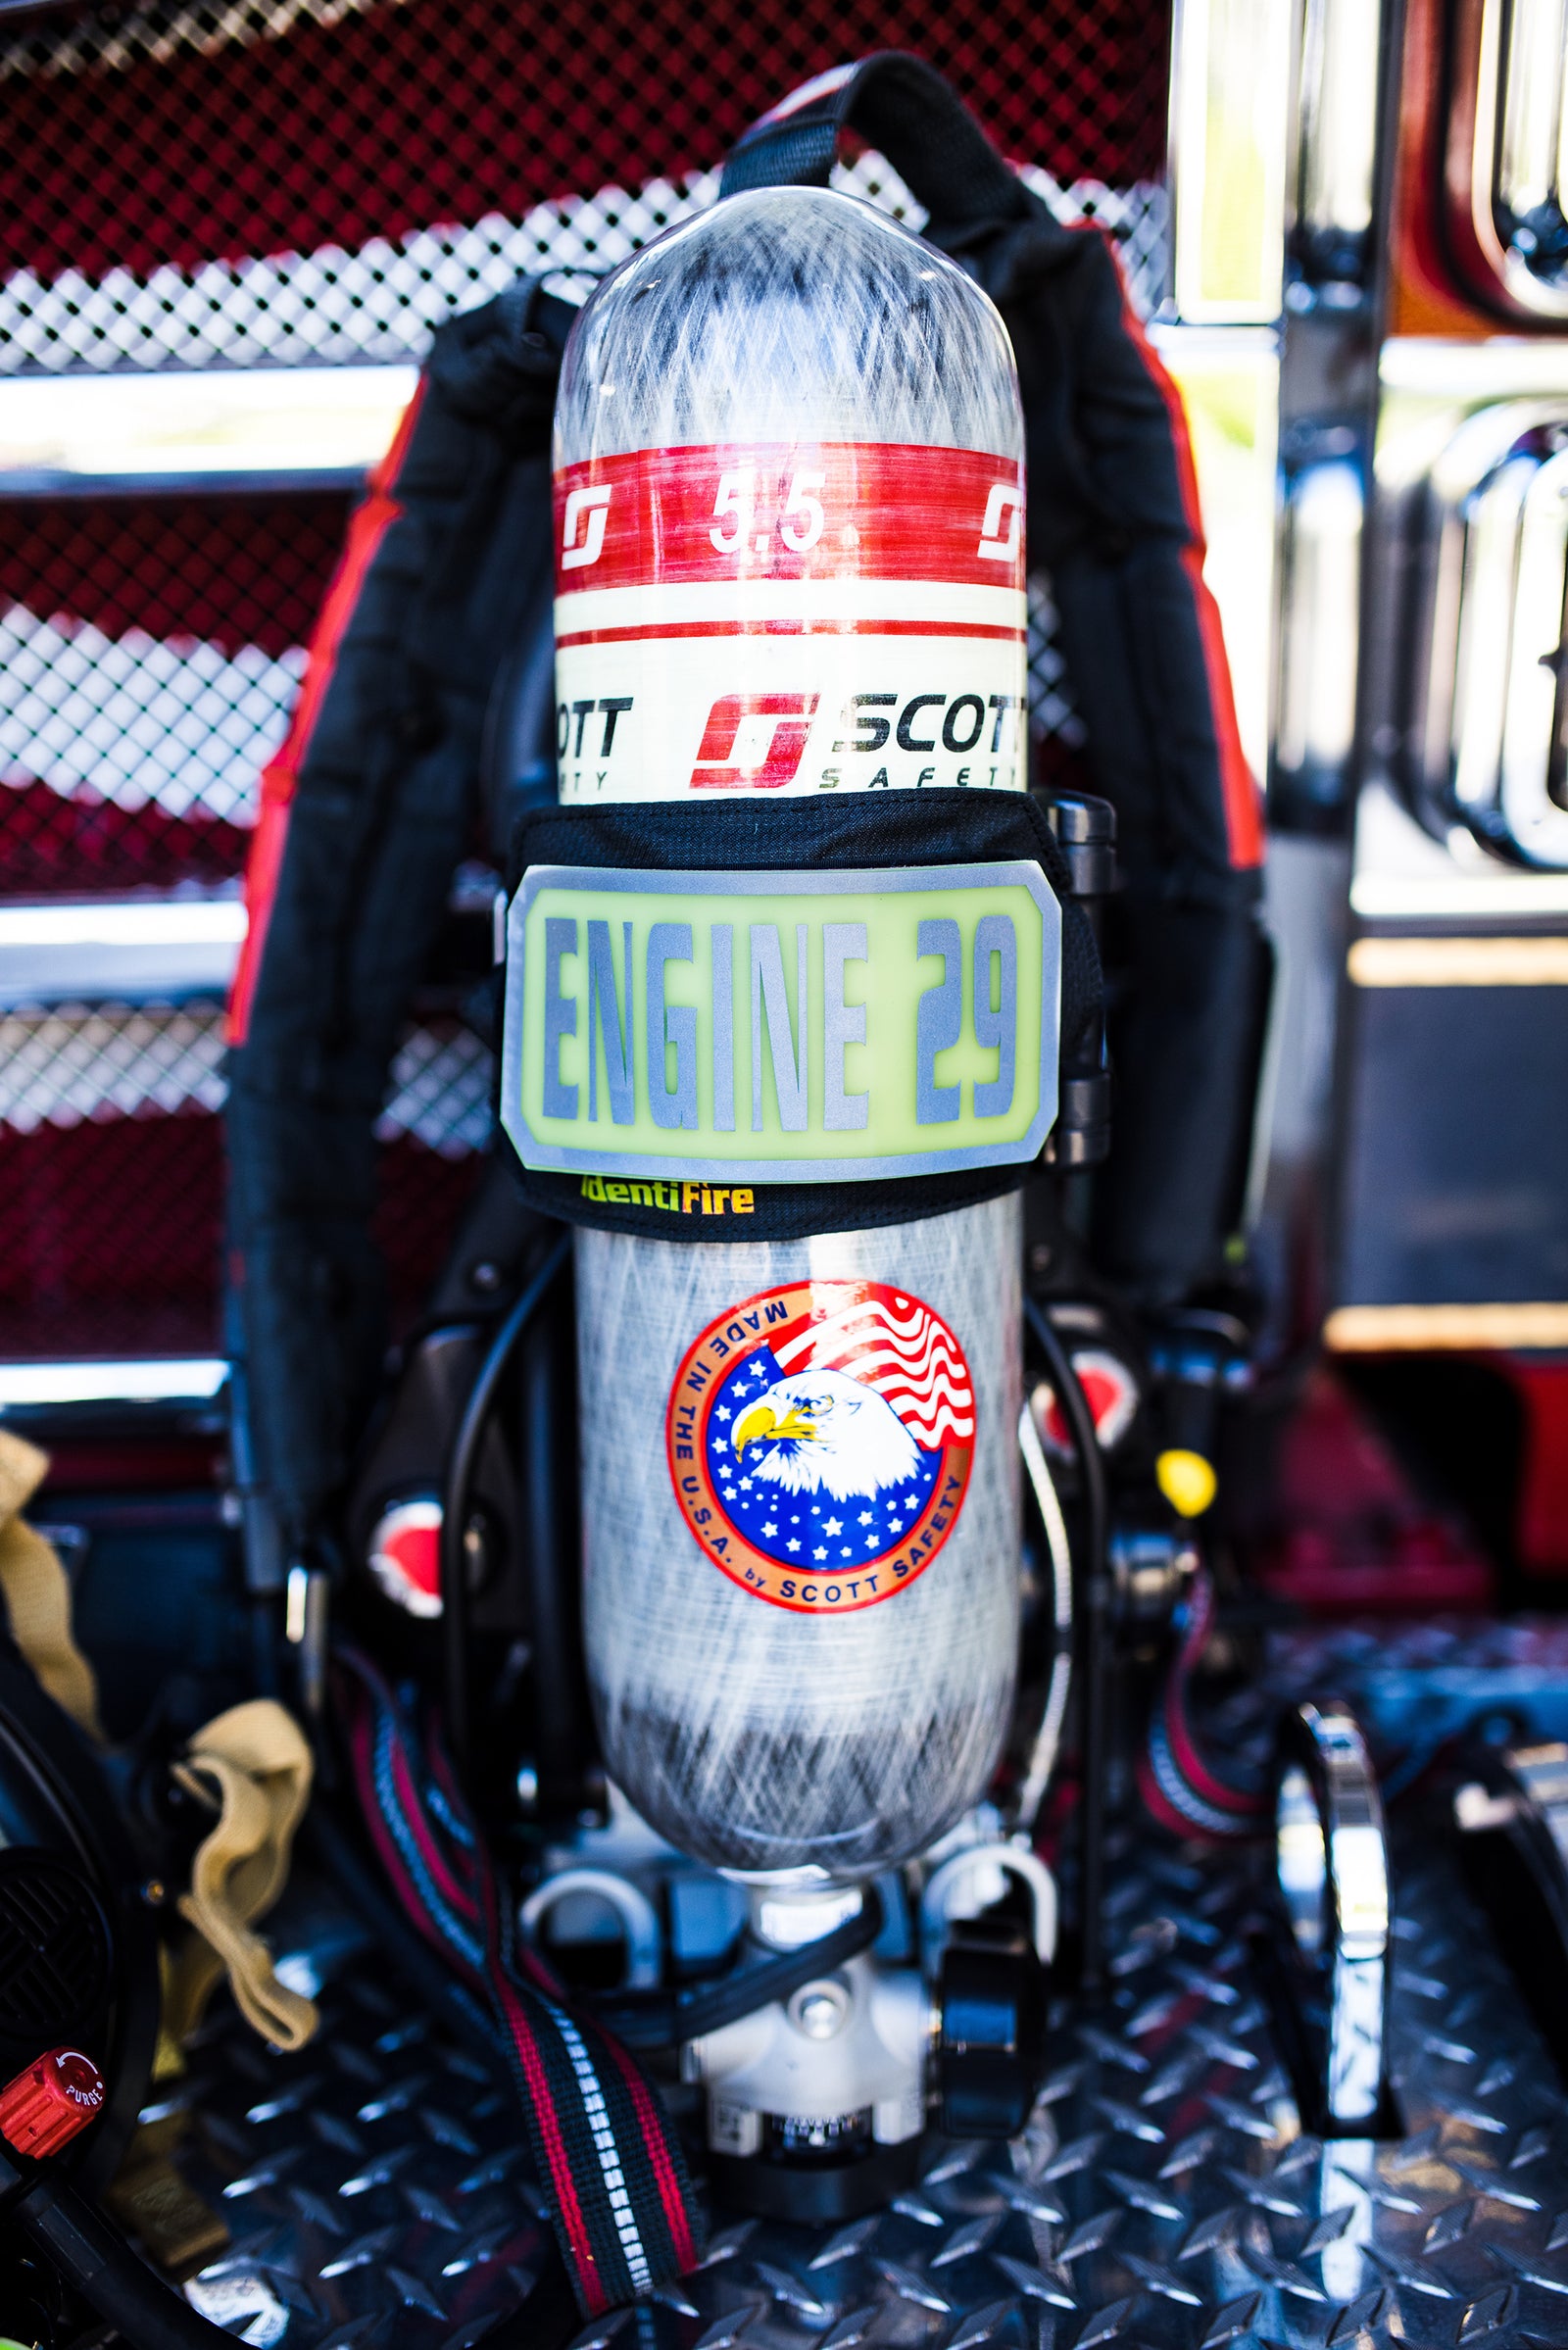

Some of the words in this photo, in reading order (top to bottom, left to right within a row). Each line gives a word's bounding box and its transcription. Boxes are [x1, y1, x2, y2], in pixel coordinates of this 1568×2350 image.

[709, 472, 825, 554] 5.5
[556, 697, 634, 759] OTT
[542, 917, 869, 1132] ENGINE
[915, 914, 1018, 1125] 29
[710, 1300, 788, 1358] MADE
[685, 1361, 711, 1393] IN
[676, 1405, 697, 1460] THE
[681, 1475, 733, 1563] U.S.A.
[892, 1475, 961, 1578] SAFETY
[744, 1568, 766, 1589] by
[779, 1574, 879, 1603] SCOTT
[66, 2084, 103, 2106] PURGE
